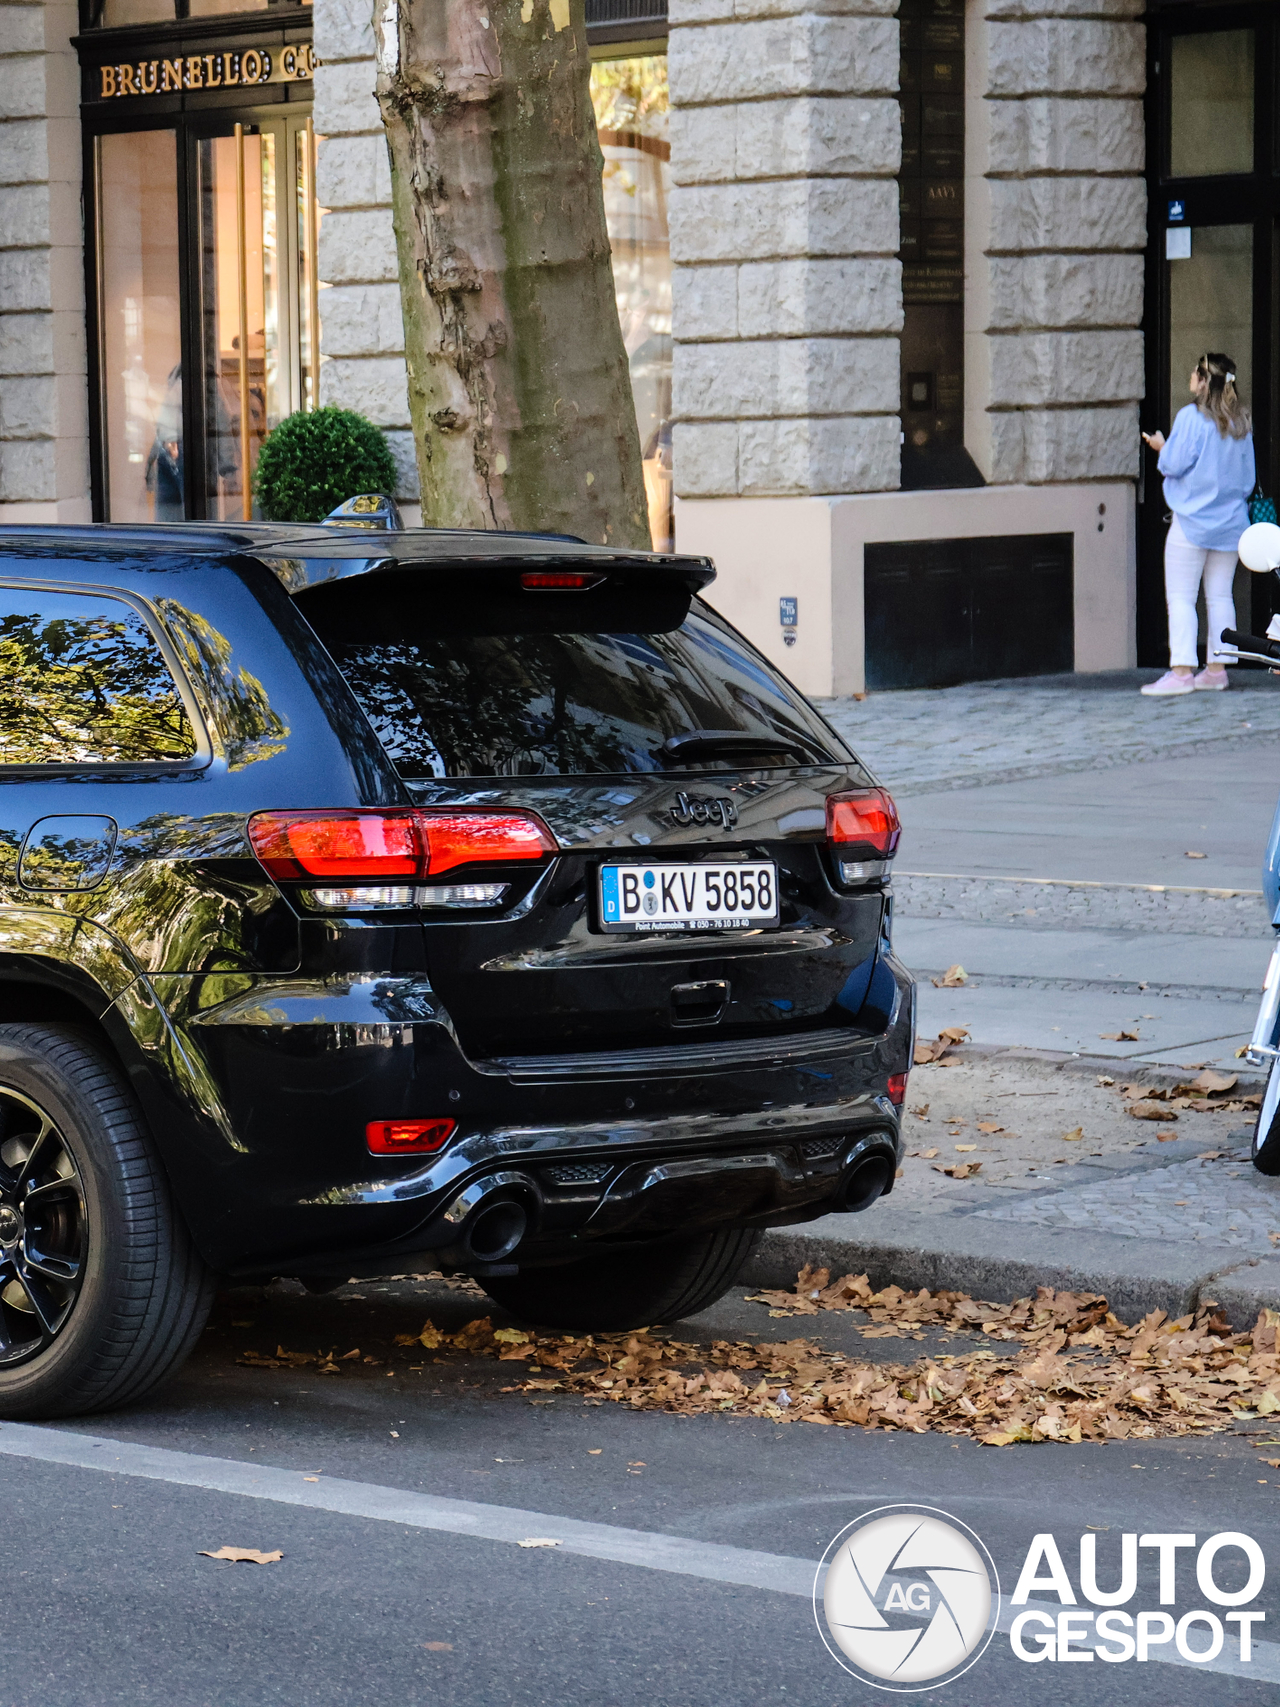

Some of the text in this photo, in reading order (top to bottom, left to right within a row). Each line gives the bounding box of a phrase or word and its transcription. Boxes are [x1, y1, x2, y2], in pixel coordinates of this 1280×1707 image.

[100, 44, 317, 98] BRUNELLO CU
[670, 791, 738, 831] Jeep
[607, 900, 616, 913] D
[622, 870, 773, 914] B KV 5858
[635, 922, 651, 931] Point
[651, 920, 685, 931] Automobile
